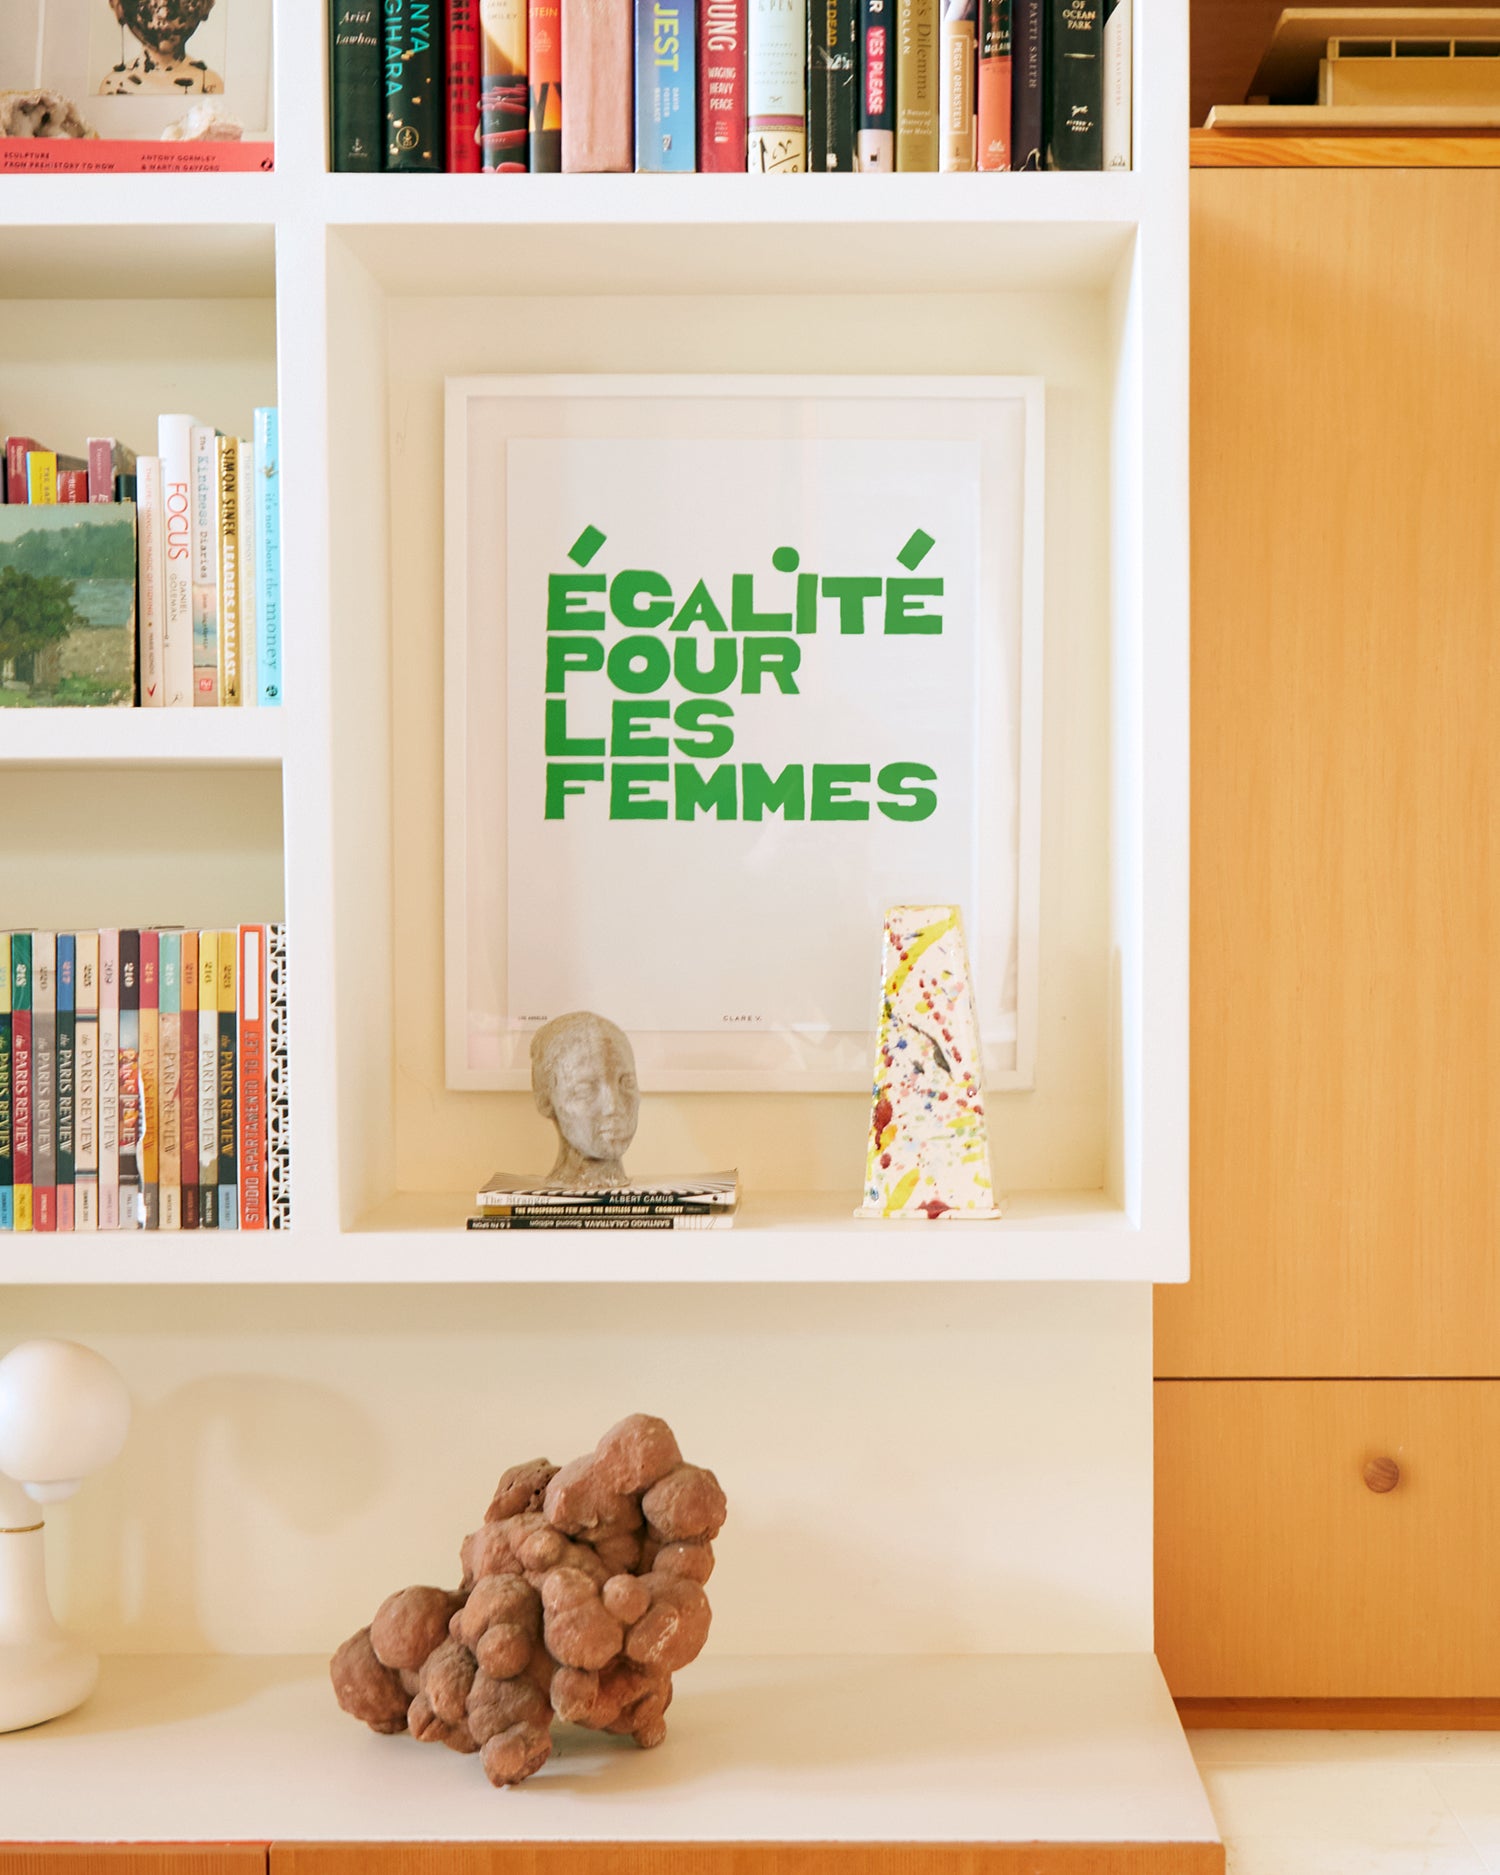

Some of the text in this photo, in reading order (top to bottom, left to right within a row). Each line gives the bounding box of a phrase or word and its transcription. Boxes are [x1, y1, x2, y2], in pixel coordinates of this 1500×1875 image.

[339, 12, 372, 26] Ariel
[410, 0, 430, 52] NYA
[530, 8, 558, 17] STEIN
[706, 0, 738, 51] UNG
[827, 10, 838, 46] DEAD
[902, 0, 913, 55] POLLAN
[1062, 9, 1096, 20] OCEAN
[1067, 20, 1092, 31] PARK
[1072, 0, 1086, 9] OF
[336, 33, 377, 46] Lawhon
[654, 4, 679, 72] JEST
[917, 23, 932, 99] Dilemma
[1029, 2, 1038, 88] PATTI SMITH
[708, 67, 736, 79] WAGING
[710, 82, 734, 95] HEAVY
[869, 29, 885, 114] YES PLEASE
[953, 41, 963, 128] PEGGY ORENSTEIN
[710, 98, 734, 111] PEACE
[198, 456, 209, 527] Kindness
[167, 483, 189, 560] FOCUS
[200, 531, 208, 579] Diaries
[223, 448, 236, 676] SIMON SINEK LEADERS EAT LAST
[546, 524, 944, 635] ÉGALITÉ
[169, 573, 178, 623] GOLEMAN
[179, 581, 188, 615] DANIEL
[262, 492, 278, 670] it's not about the money
[545, 634, 801, 695] POUR
[544, 698, 735, 759] LES
[544, 762, 938, 822] FEMMES
[0, 1053, 10, 1095] PARIS
[38, 1052, 51, 1096] PARIS
[60, 1034, 73, 1155] the PARIS REVIEW
[81, 1050, 93, 1093] PARIS
[104, 1049, 116, 1092] PARIS
[123, 1049, 136, 1093] PARIS
[144, 1048, 156, 1091] PARIS
[163, 1052, 176, 1094] PARIS
[203, 1050, 215, 1093] PARIS
[221, 1051, 234, 1095] PARIS
[16, 1035, 28, 1156] the PARIS REVIEW
[184, 1050, 196, 1153] PARIS REVIEW
[0, 1100, 10, 1159] REVIEW
[38, 1099, 51, 1157] REVIEW
[81, 1097, 93, 1154] REVIEW
[104, 1096, 116, 1152] REVIEW
[164, 1099, 176, 1157] REVIEW
[203, 1098, 215, 1153] REVIEW
[221, 1099, 234, 1157] REVIEW
[245, 1029, 259, 1222] STUDIO APARTAMENTO TO LET
[483, 1195, 503, 1205] The
[515, 1207, 527, 1215] THE
[527, 1207, 565, 1215] PROSPEROUS
[566, 1207, 578, 1215] FEW
[579, 1207, 592, 1215] AND
[593, 1207, 604, 1215] THE
[605, 1206, 631, 1214] RESTLESS
[632, 1206, 649, 1214] MANY
[655, 1206, 684, 1214] CHOMSKY
[530, 1219, 671, 1228] SANTIAGO CALATRAVA Second edition
[609, 1195, 674, 1203] ALBERT CAMUS
